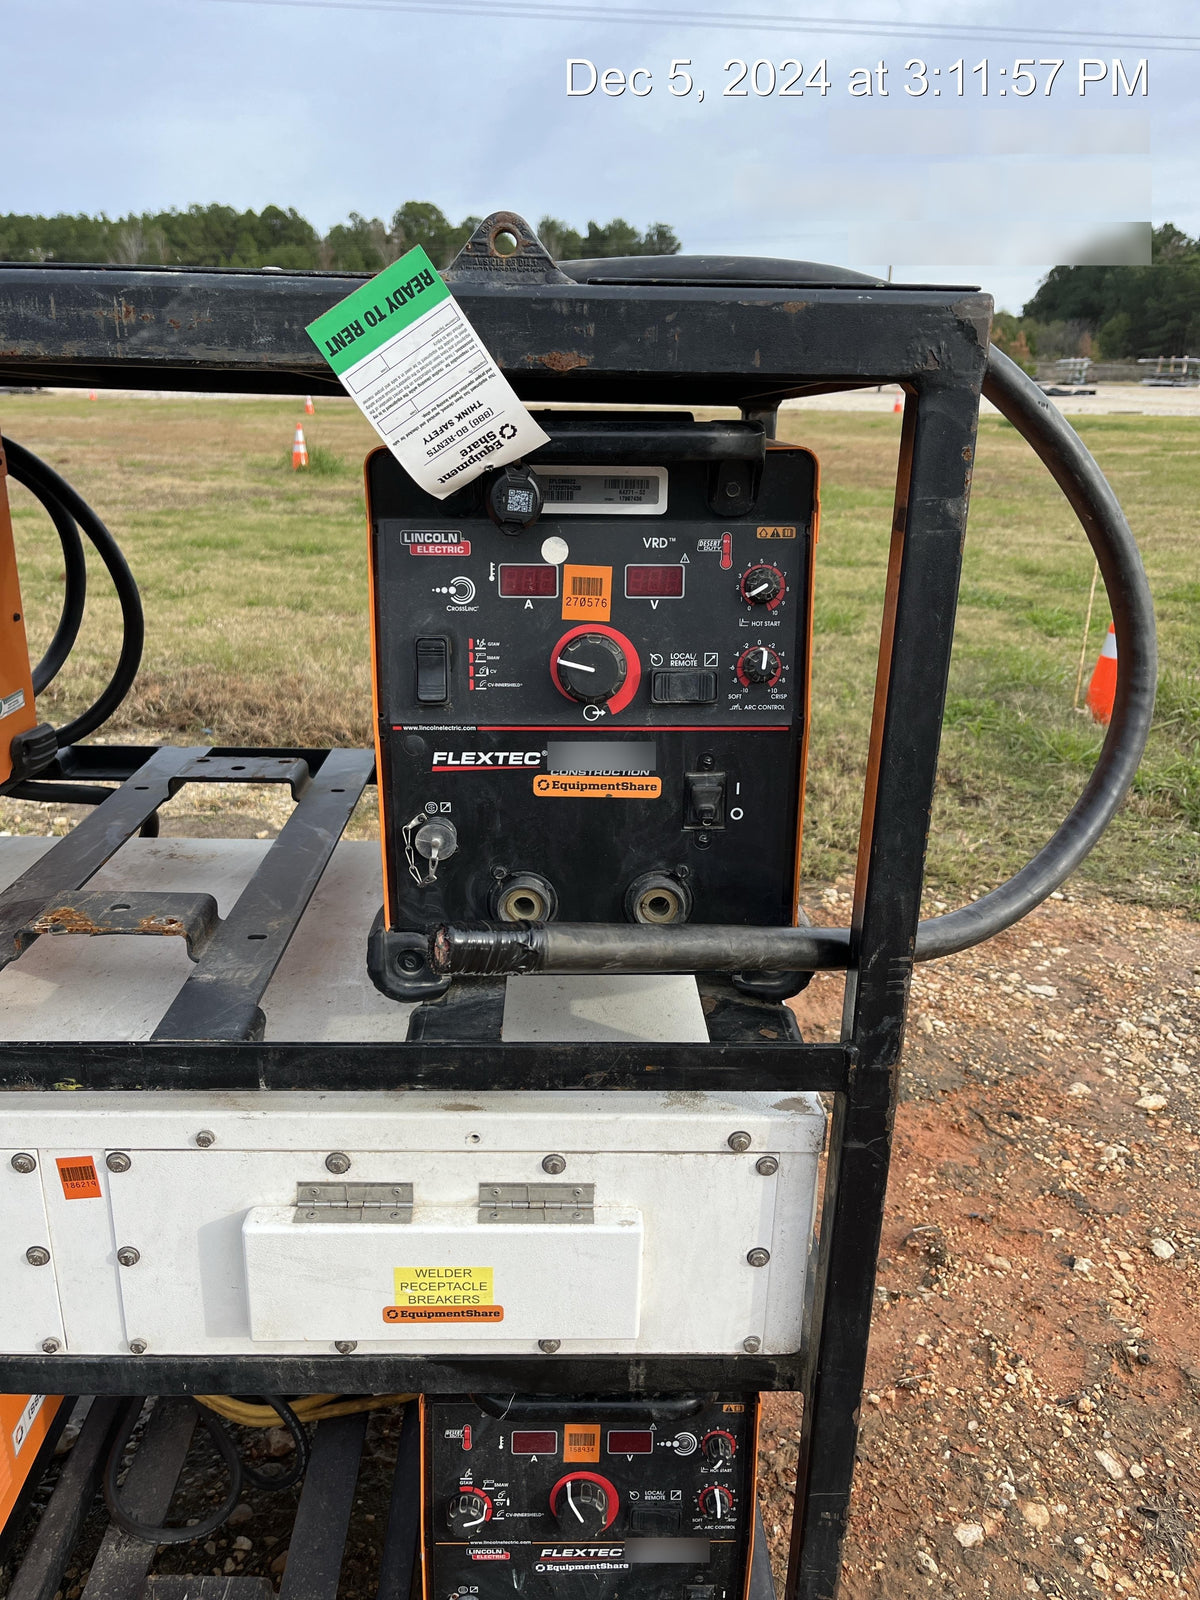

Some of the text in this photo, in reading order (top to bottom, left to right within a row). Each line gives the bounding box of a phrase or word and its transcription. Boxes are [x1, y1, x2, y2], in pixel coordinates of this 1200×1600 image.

[384, 268, 434, 314] READY
[362, 305, 387, 328] TO
[324, 319, 365, 357] RENT
[422, 399, 482, 445] THINK SAFETY
[425, 406, 494, 457] (888) 80-RENTS
[459, 430, 496, 458] Share
[436, 438, 503, 485] Equipment
[404, 533, 458, 543] LINCOLN
[416, 545, 464, 554] ELECTRIC
[524, 599, 534, 609] A
[565, 597, 608, 608] 270576
[650, 600, 659, 610] V
[670, 652, 697, 660] LOCAL/
[552, 780, 657, 791] EquipmentShare
[65, 1181, 97, 1189] 186219
[415, 1268, 472, 1278] WELDER
[400, 1282, 487, 1291] RECEPTACLE
[408, 1295, 480, 1304] BREAKERS
[400, 1310, 500, 1319] EquipmentShare
[540, 1549, 623, 1557] FLEXTEC
[546, 1563, 629, 1572] EquipmentShare
